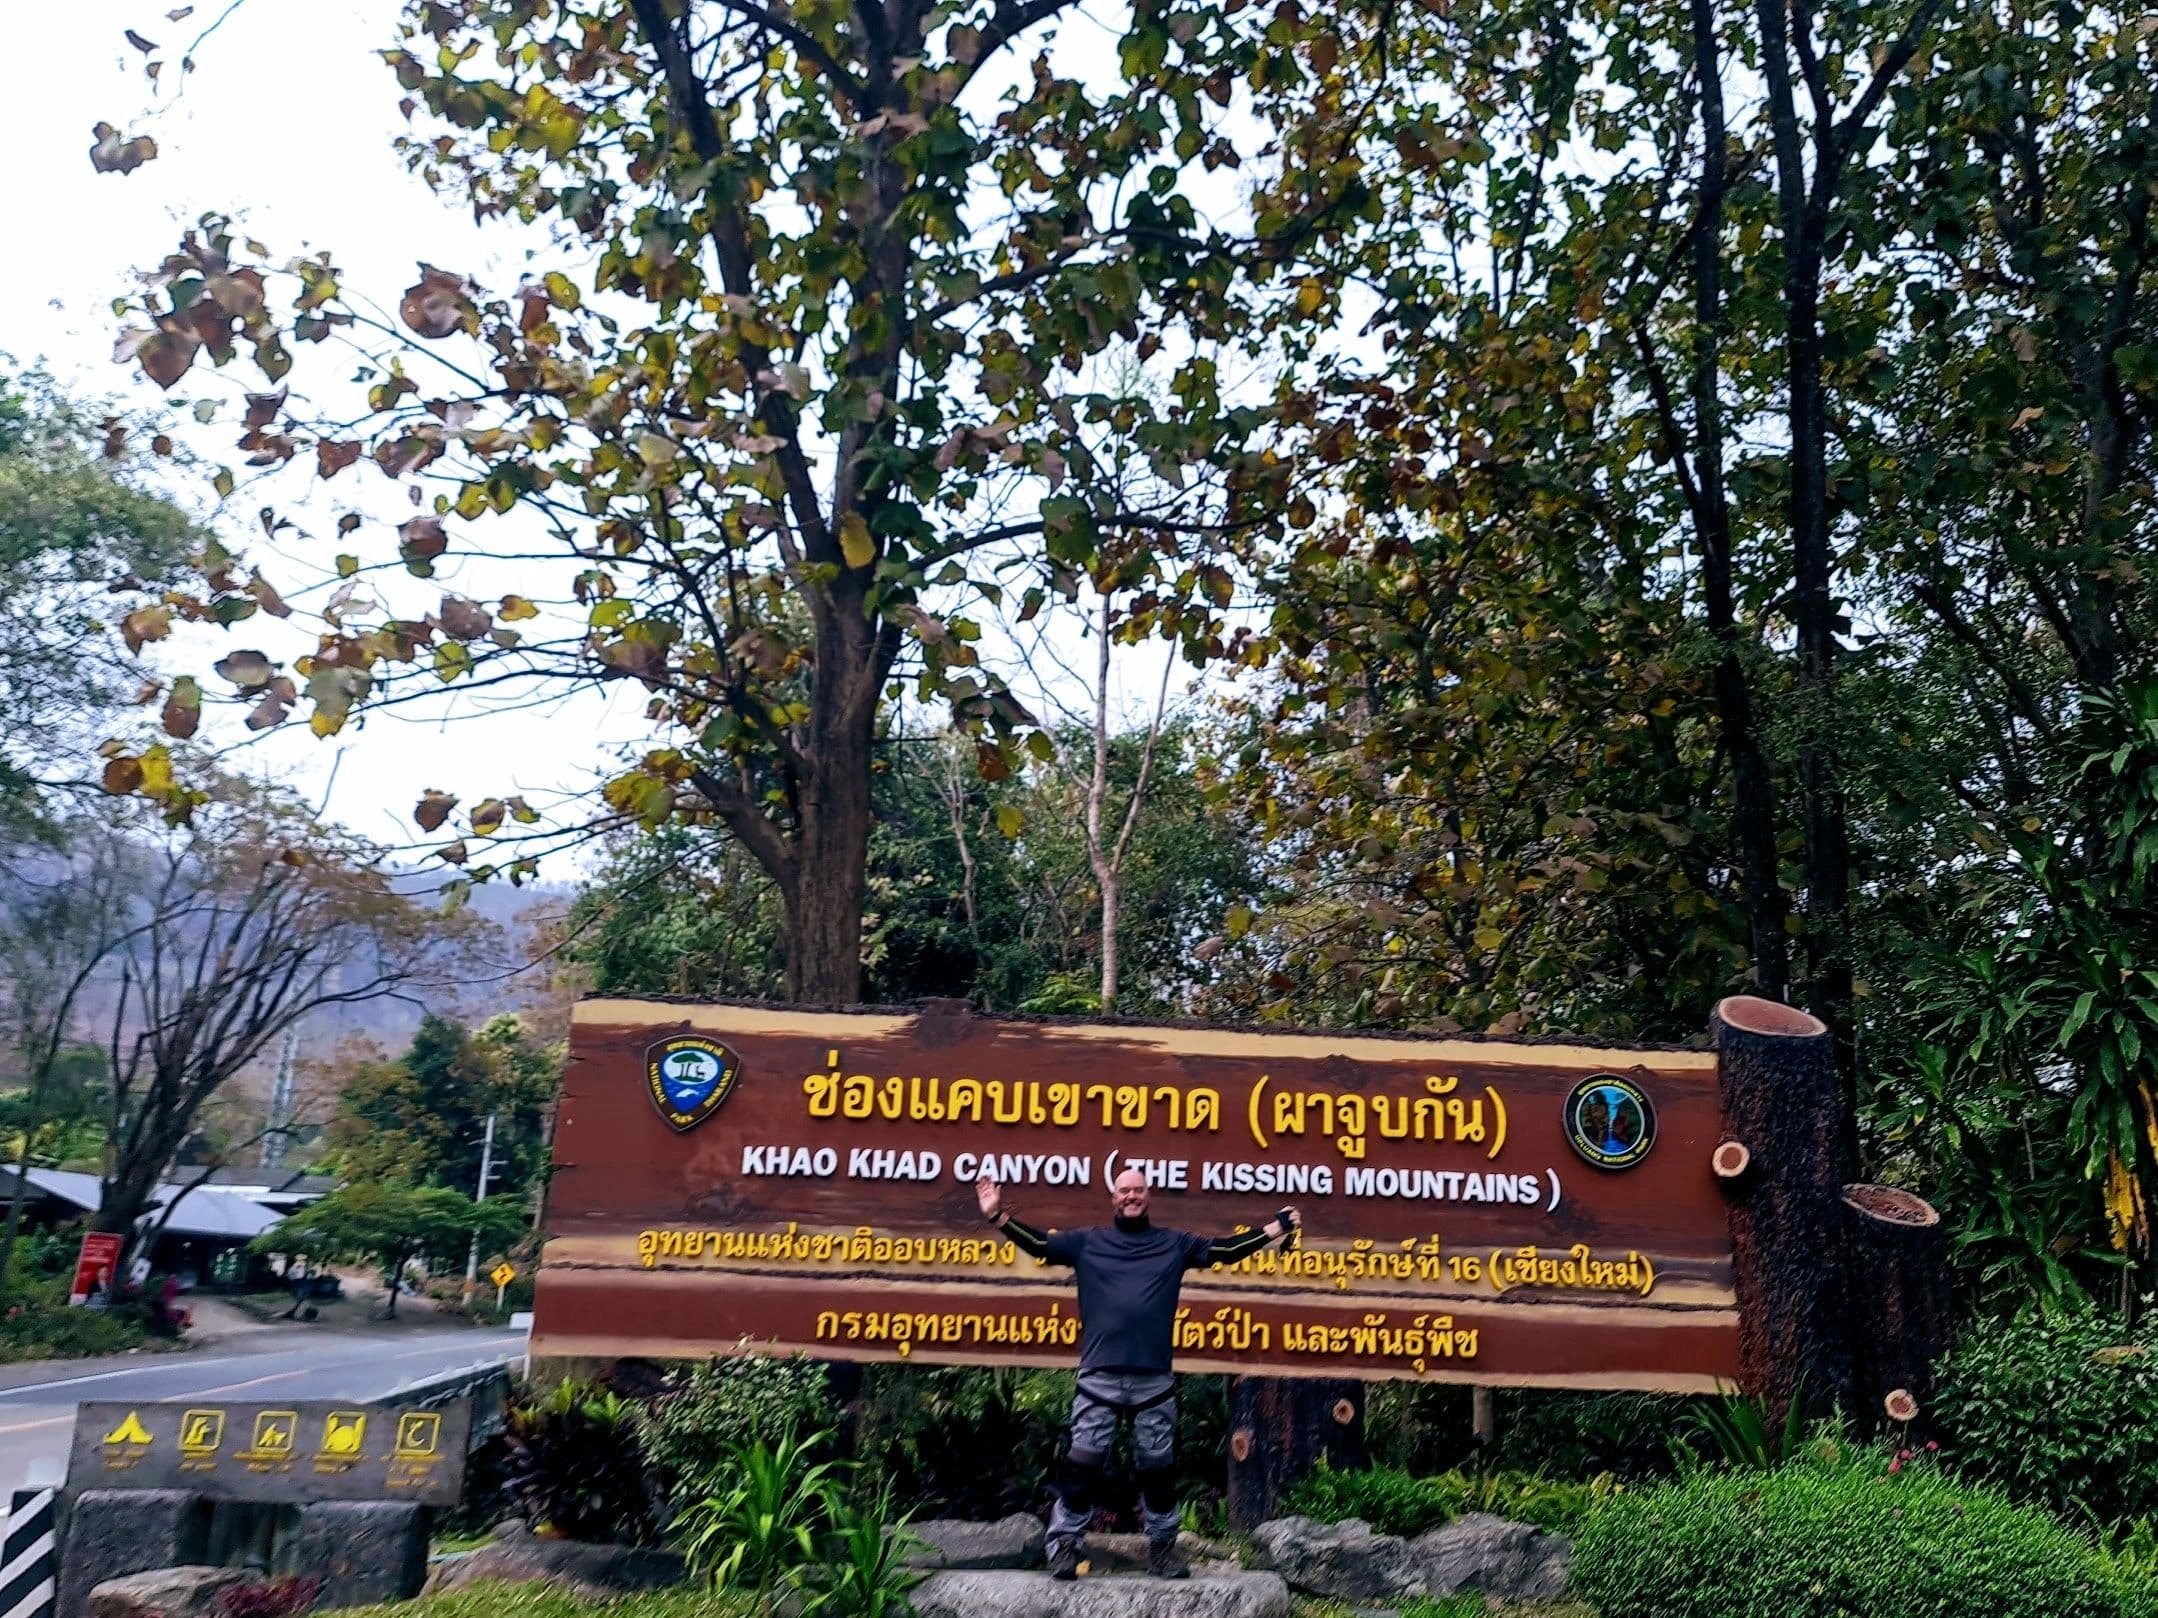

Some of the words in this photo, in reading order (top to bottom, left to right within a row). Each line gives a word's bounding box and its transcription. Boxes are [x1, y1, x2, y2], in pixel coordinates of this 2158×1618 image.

[802, 1049, 1221, 1131] ช่องแคบเขาขาด
[1247, 1074, 1508, 1160] (ผาจูบกัน)
[741, 1145, 838, 1177] KHAO
[847, 1147, 943, 1180] KHAD
[953, 1151, 1091, 1186] CANYON
[1201, 1160, 1334, 1195] KISSING
[637, 1221, 1017, 1267] อุทยานแห่งชาติออบหลวง
[1447, 1254, 1483, 1283] 16
[1487, 1242, 1656, 1297] (เชียงใหม่)
[1282, 1312, 1479, 1375] และพันธุ์พืช
